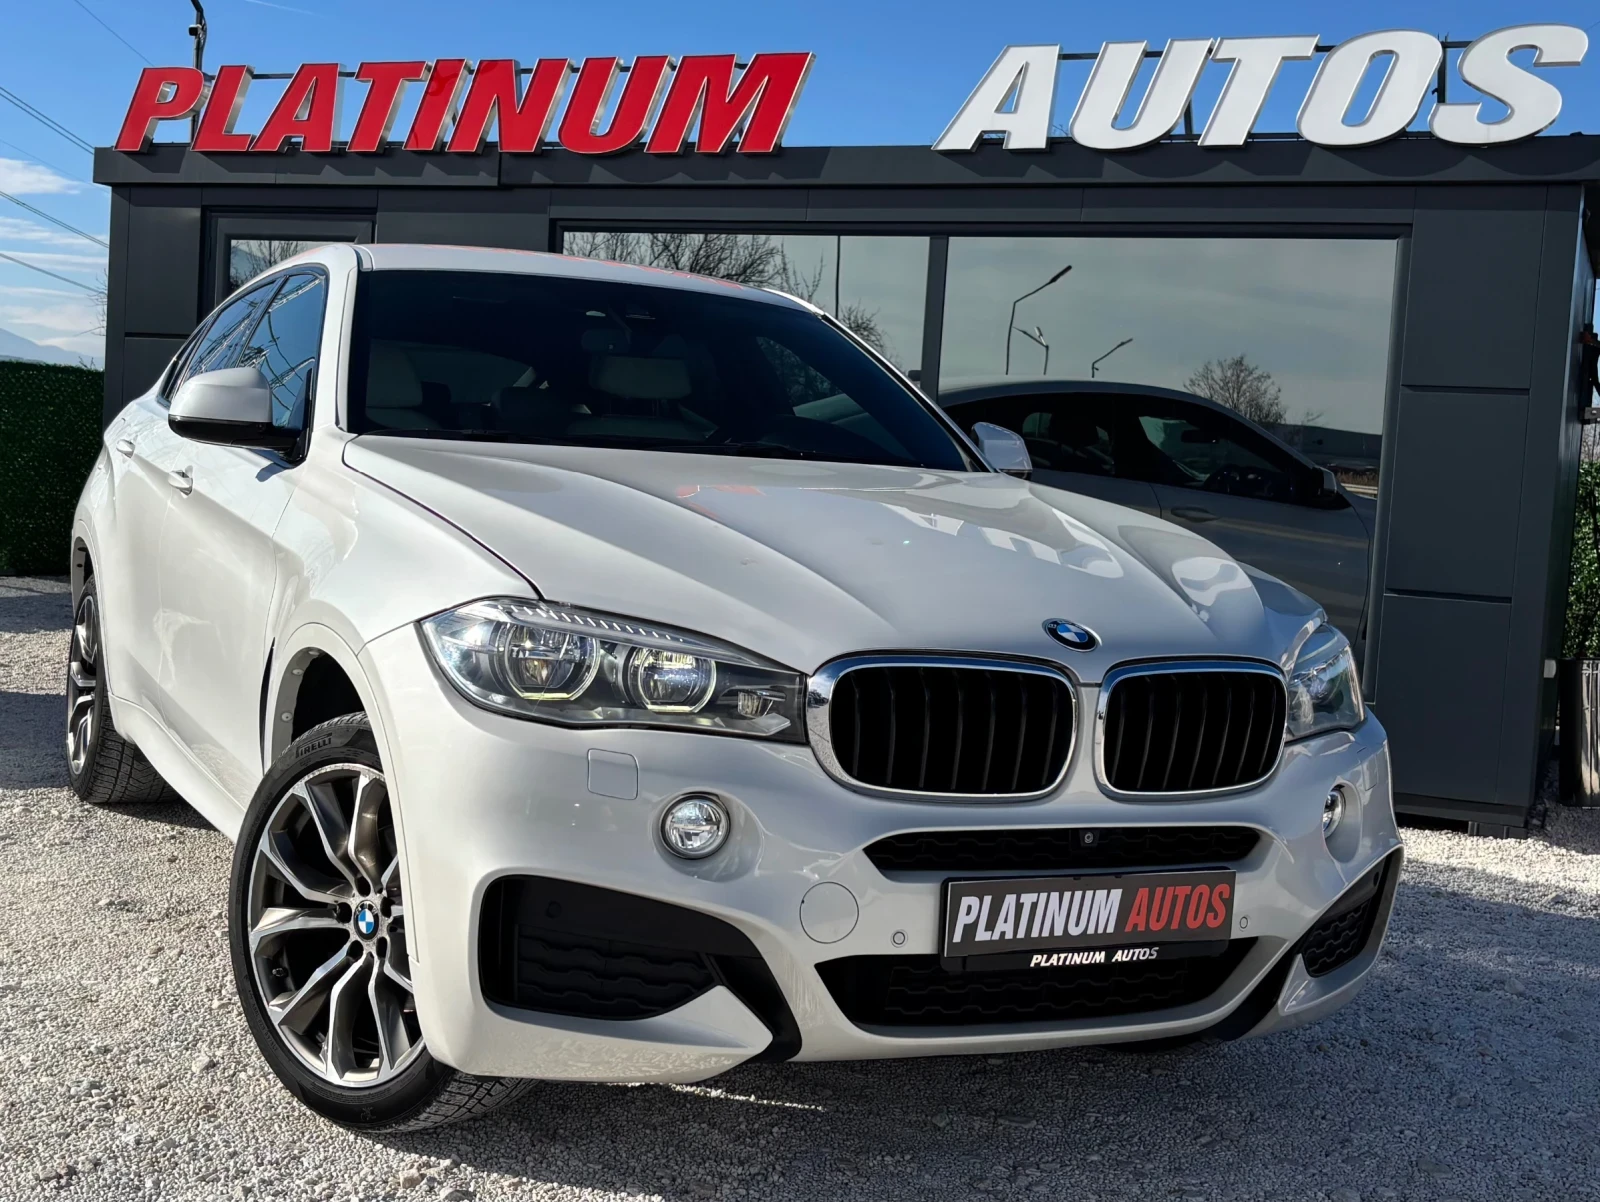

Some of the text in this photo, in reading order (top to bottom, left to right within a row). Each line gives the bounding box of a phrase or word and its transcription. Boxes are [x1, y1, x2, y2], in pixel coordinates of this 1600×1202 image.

[113, 23, 1589, 154] PLATINUM AUTOS
[296, 732, 332, 758] PIRELLI
[952, 883, 1231, 943] PLATINUM AUTOS
[1030, 947, 1160, 968] PLATINUM AUTOS
